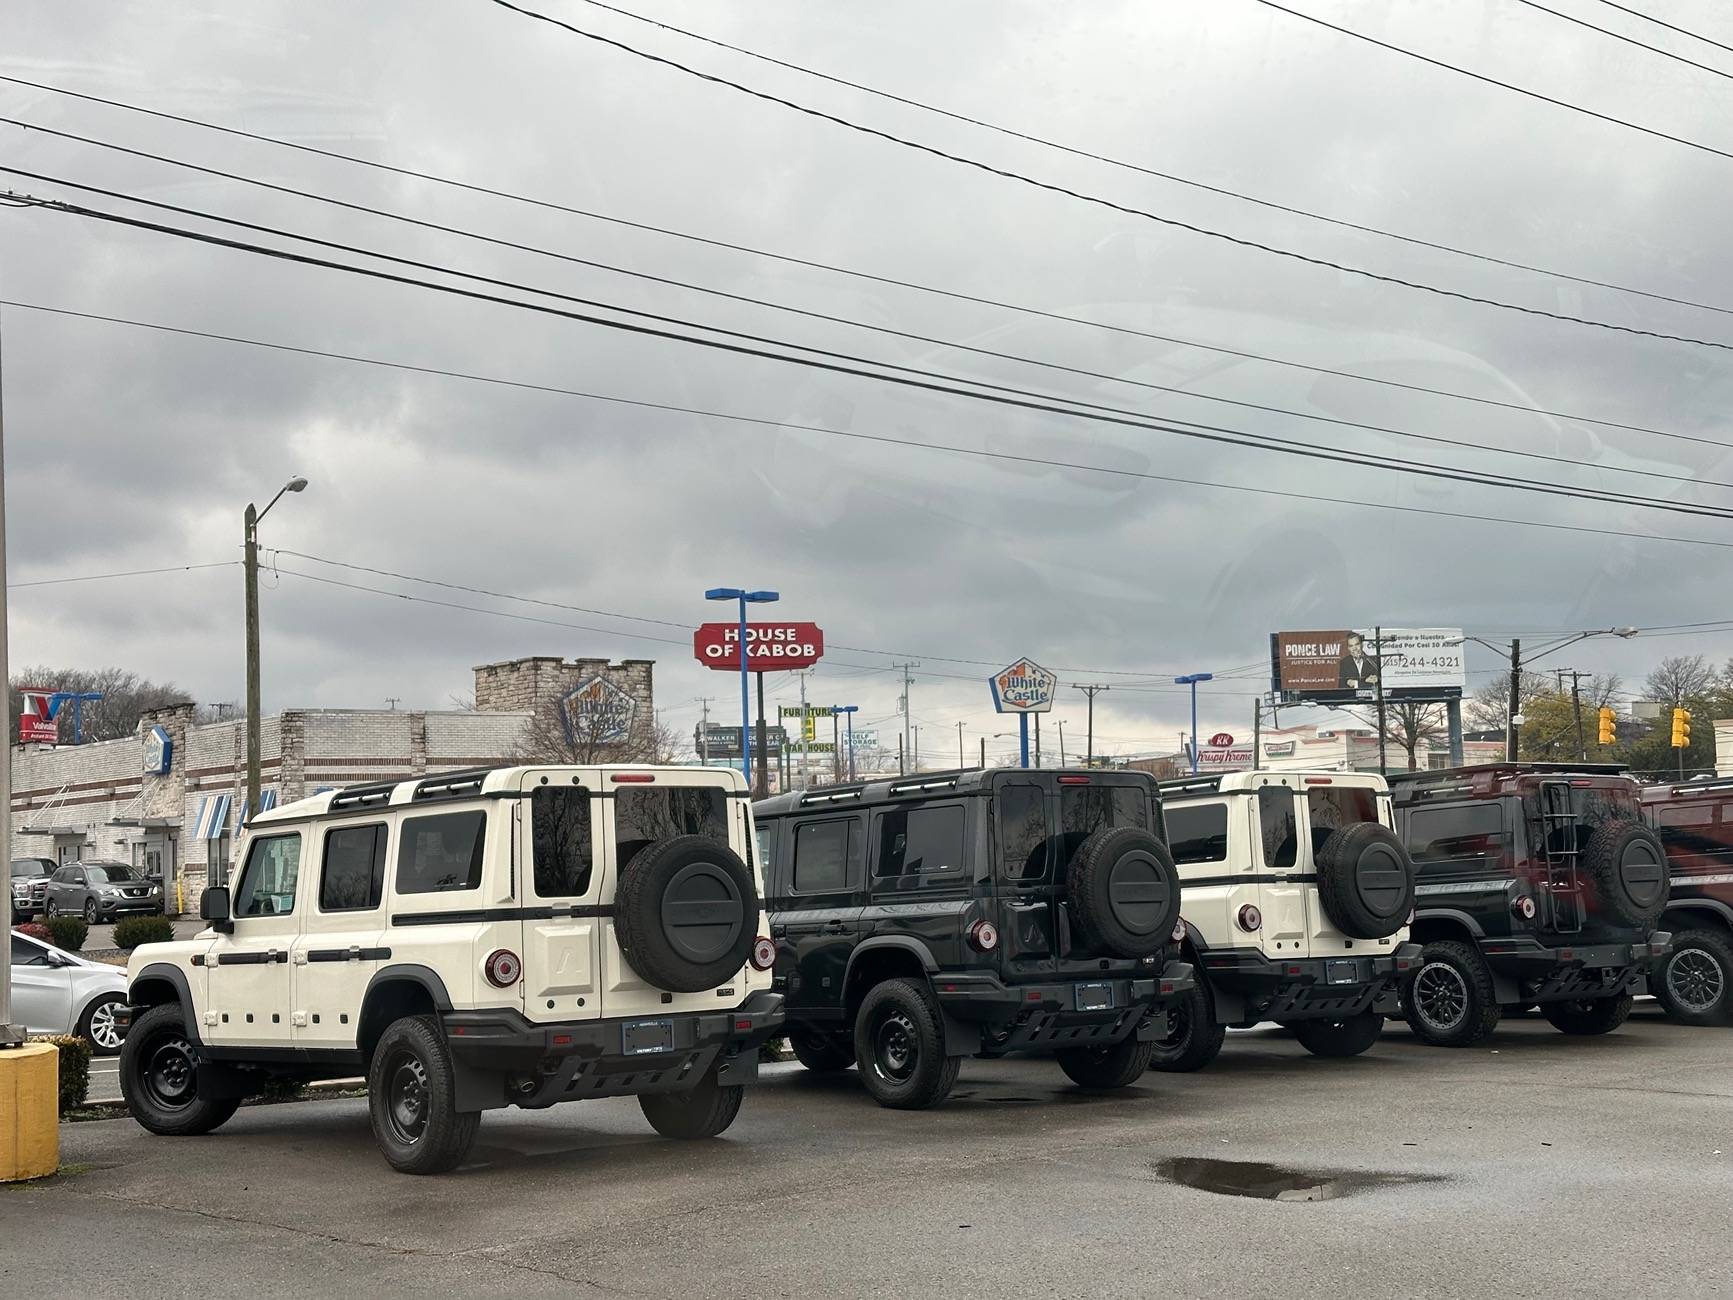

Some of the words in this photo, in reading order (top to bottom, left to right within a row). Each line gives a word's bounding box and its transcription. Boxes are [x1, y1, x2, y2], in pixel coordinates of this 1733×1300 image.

[724, 628, 796, 641] HOUSE
[705, 644, 733, 657] OF
[744, 643, 815, 657] KABOB
[1285, 643, 1317, 656] PONCE
[1319, 643, 1340, 656] LAW
[1402, 656, 1460, 668] 244-4321
[1008, 676, 1046, 690] White
[1003, 689, 1048, 701] Castle
[784, 743, 834, 752] WARHOUSE
